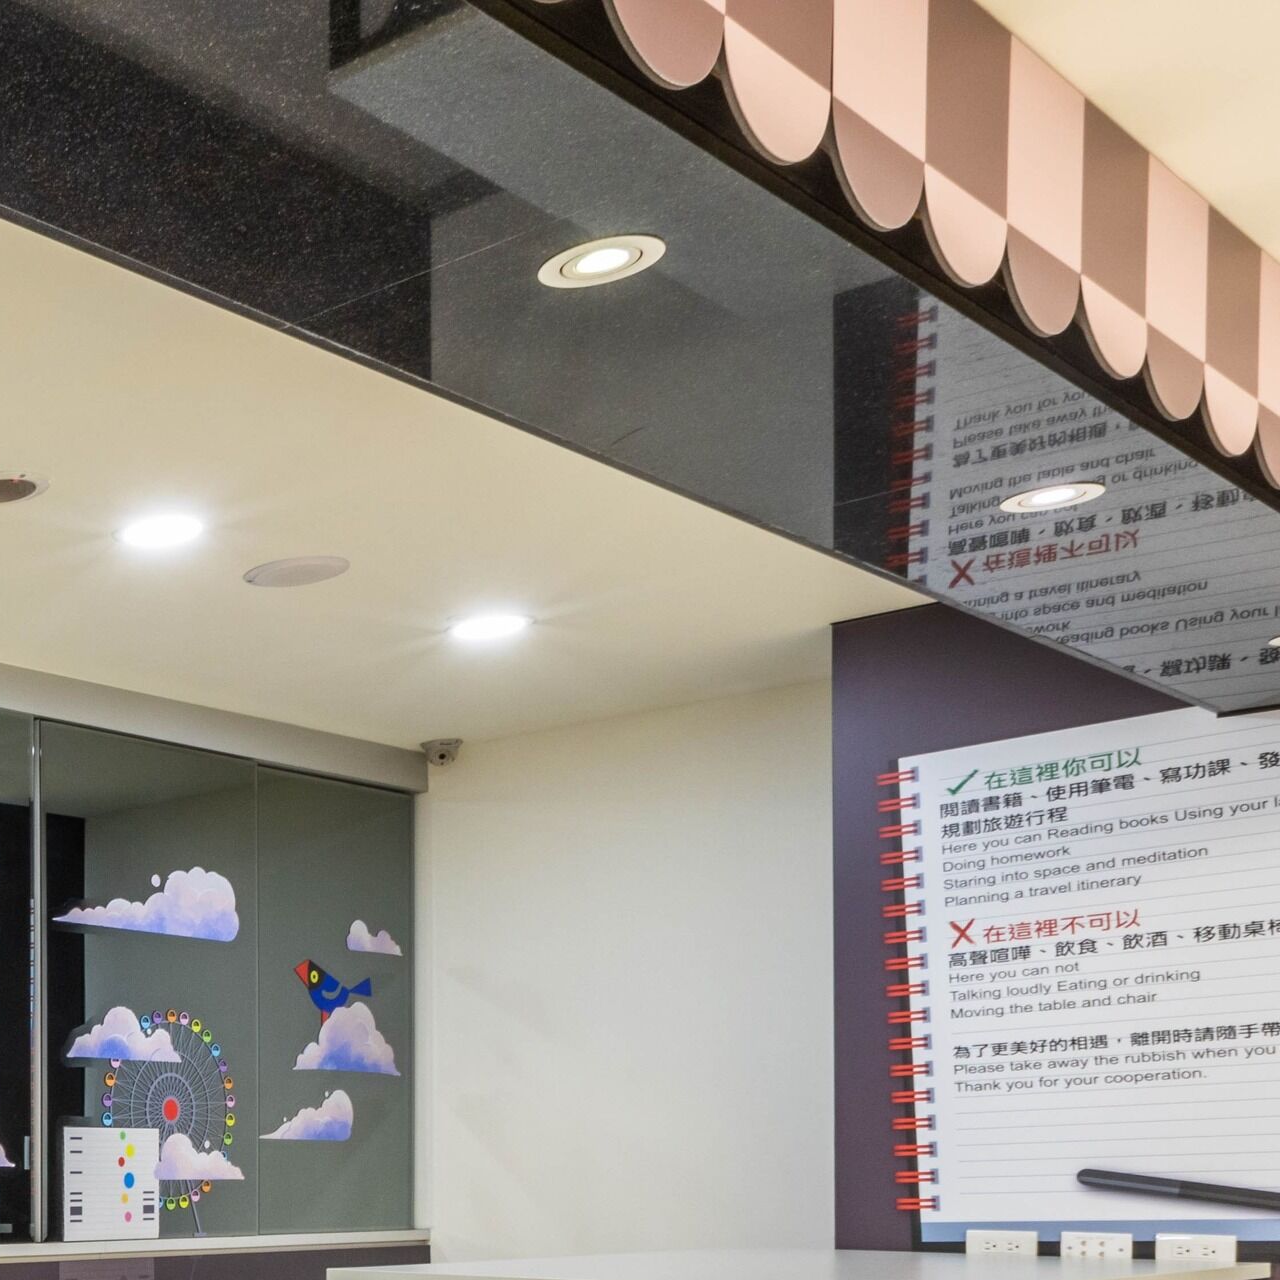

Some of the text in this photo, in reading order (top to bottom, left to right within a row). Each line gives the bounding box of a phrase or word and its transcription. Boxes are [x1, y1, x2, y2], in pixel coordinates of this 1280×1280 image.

[984, 748, 1141, 790] 在這裡你可以
[941, 806, 1068, 839] 規劃旅遊行程
[942, 842, 977, 854] Here
[983, 838, 1009, 851] you
[1014, 832, 1042, 843] can
[1048, 822, 1113, 839] Reading
[1119, 813, 1169, 830] books
[1175, 806, 1223, 822] Using
[1230, 799, 1268, 816] your
[943, 846, 1070, 872] Doing homework
[944, 847, 1209, 890] Staring into space and meditation
[944, 875, 1141, 907] Planning a travel itinerary
[983, 909, 1140, 943] 在這裡不可以
[949, 962, 1080, 983] Here you can not
[950, 970, 1200, 1002] Talking loudly Eating or drinking
[950, 992, 1158, 1019] Moving the table and chair
[954, 1045, 1276, 1075] Please take away the rubbish when you
[954, 1069, 1207, 1092] Thank you for your cooperation.
